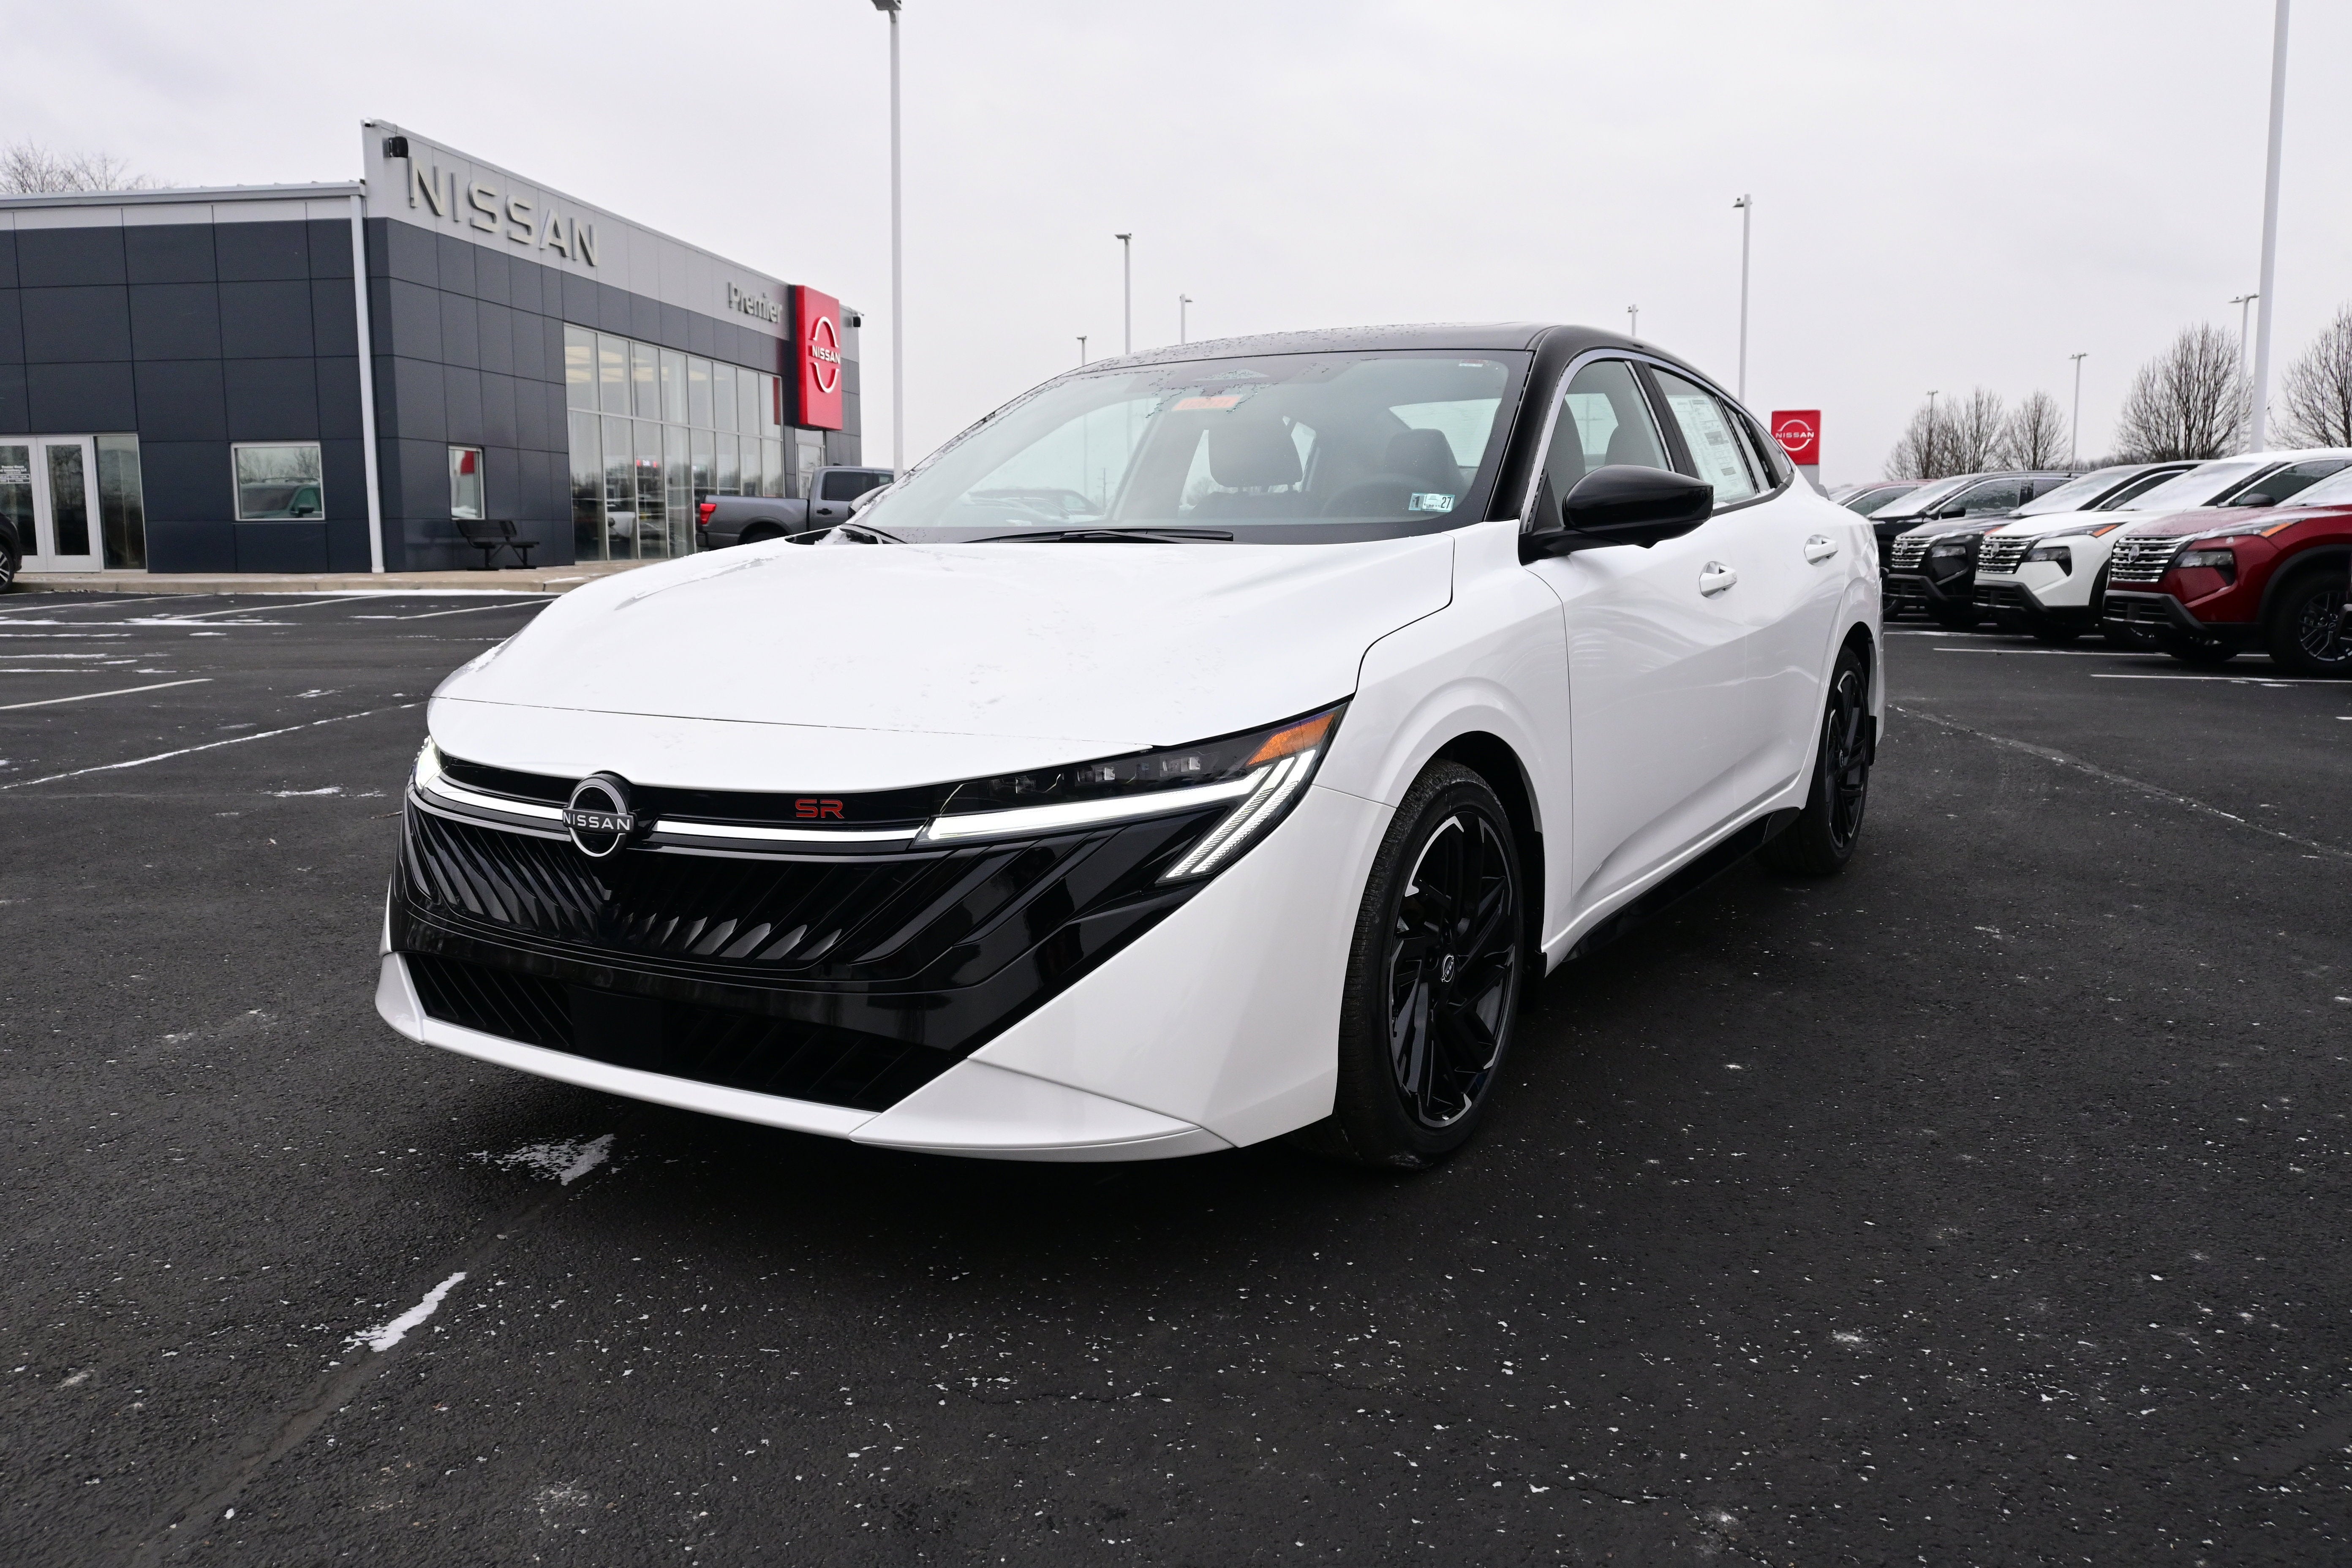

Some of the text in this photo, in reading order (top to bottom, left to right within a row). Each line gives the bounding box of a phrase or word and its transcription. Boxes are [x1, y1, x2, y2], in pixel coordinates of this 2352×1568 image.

[408, 156, 597, 266] NISSAN
[728, 282, 782, 323] Premier
[810, 344, 840, 364] NISSAN
[1414, 496, 1420, 508] 1
[1441, 497, 1452, 509] 27
[795, 798, 845, 819] SR
[563, 811, 630, 830] NISSAN
